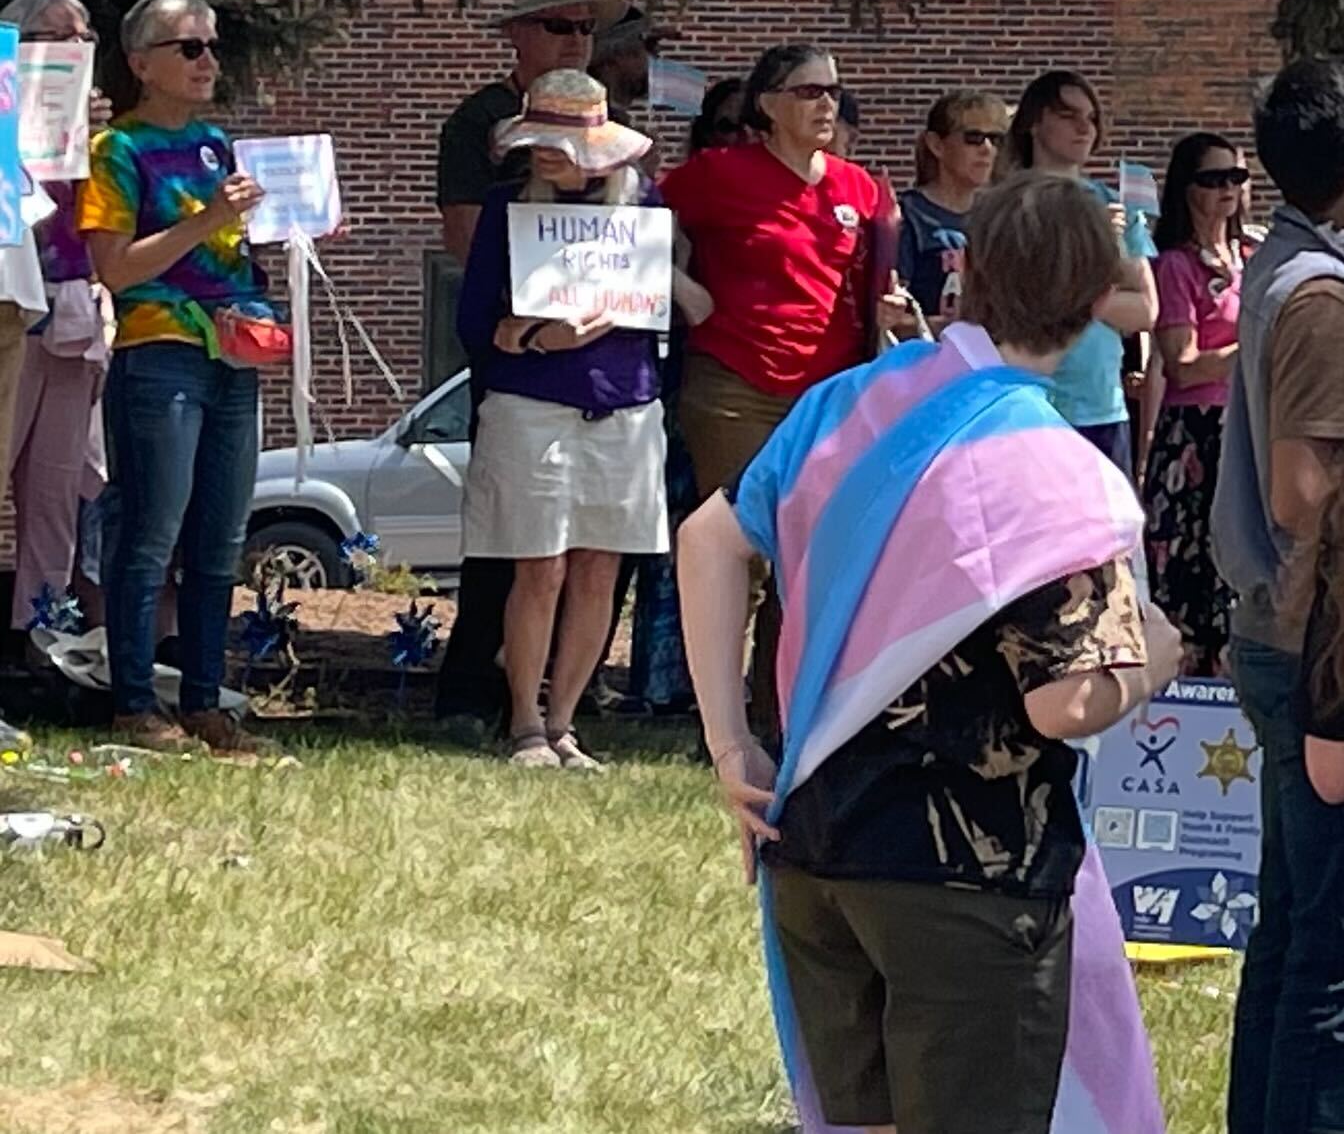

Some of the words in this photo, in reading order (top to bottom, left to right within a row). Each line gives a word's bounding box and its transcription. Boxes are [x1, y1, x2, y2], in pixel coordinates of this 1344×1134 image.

[537, 214, 637, 246] HUMAN
[562, 248, 631, 271] RIGHTS
[1121, 776, 1181, 795] CASA
